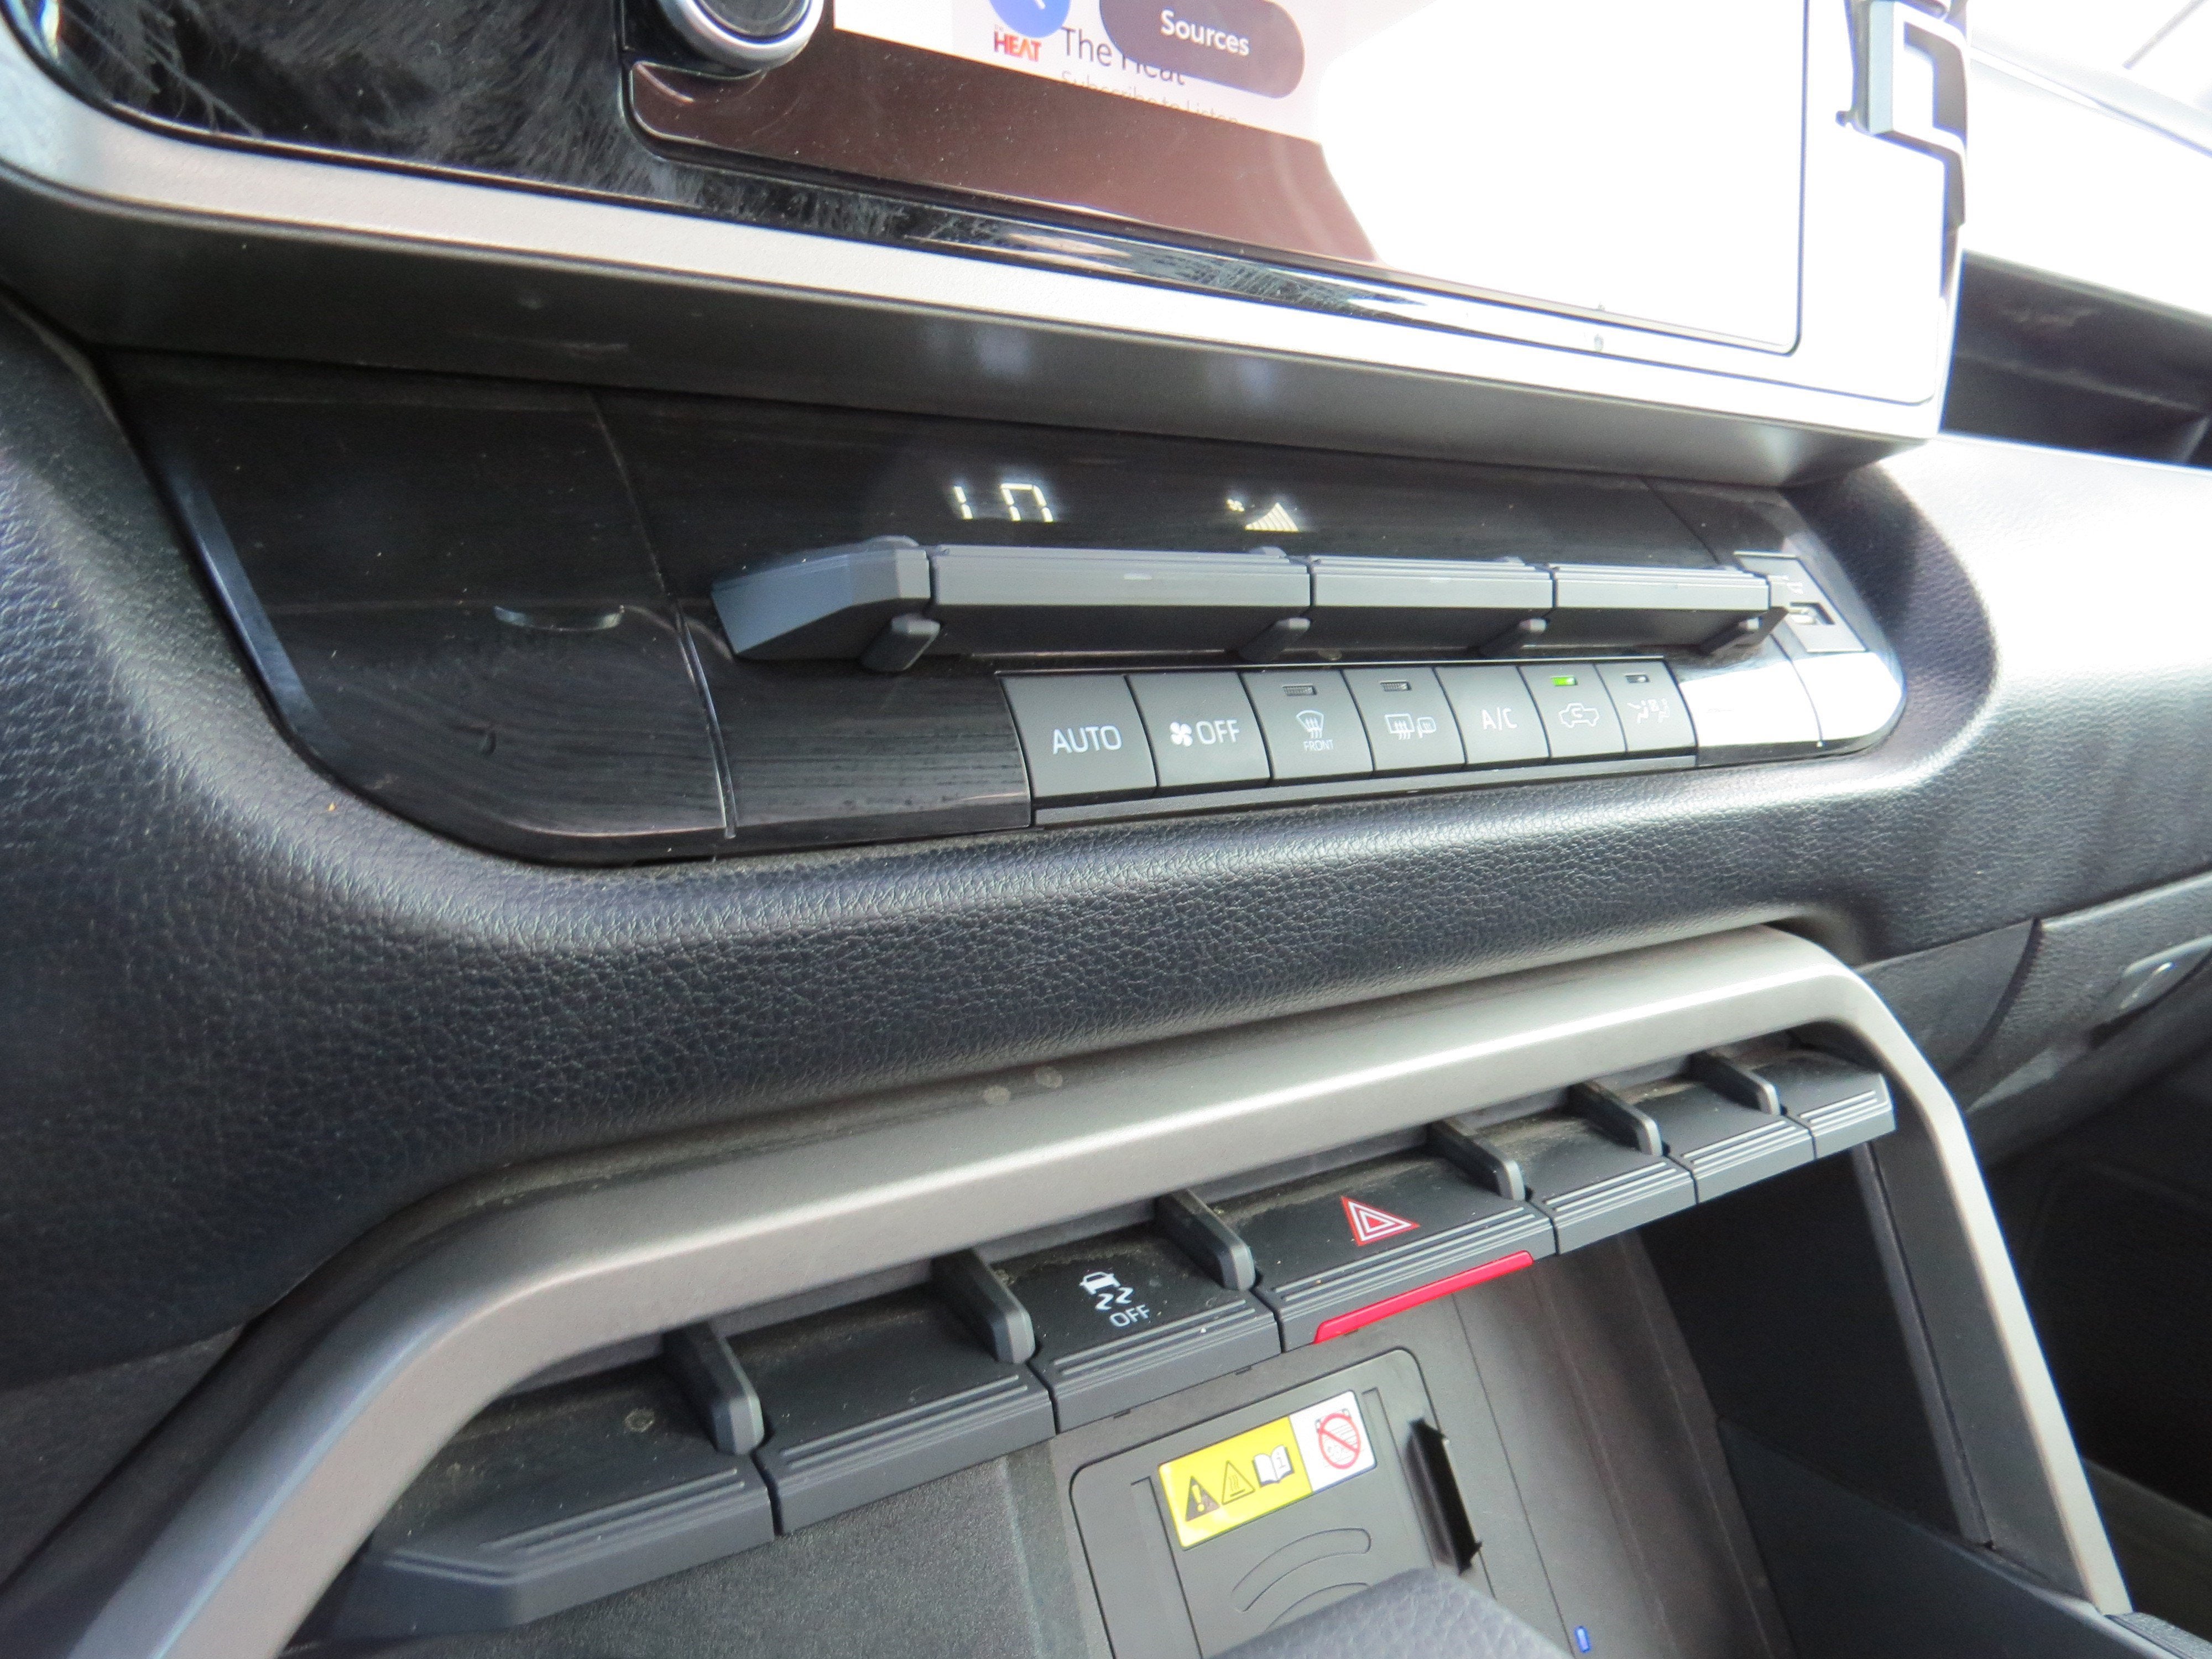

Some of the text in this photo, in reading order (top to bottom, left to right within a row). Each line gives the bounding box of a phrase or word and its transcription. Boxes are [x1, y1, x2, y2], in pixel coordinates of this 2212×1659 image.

[994, 30, 1041, 62] HEAT
[1061, 26, 1113, 67] The
[1161, 10, 1250, 56] Sources
[1197, 720, 1240, 745] OFF
[1481, 707, 1517, 731] A/C
[1053, 725, 1123, 754] AUTO
[1303, 739, 1334, 751] FRONT
[1109, 1304, 1150, 1327] OFF
